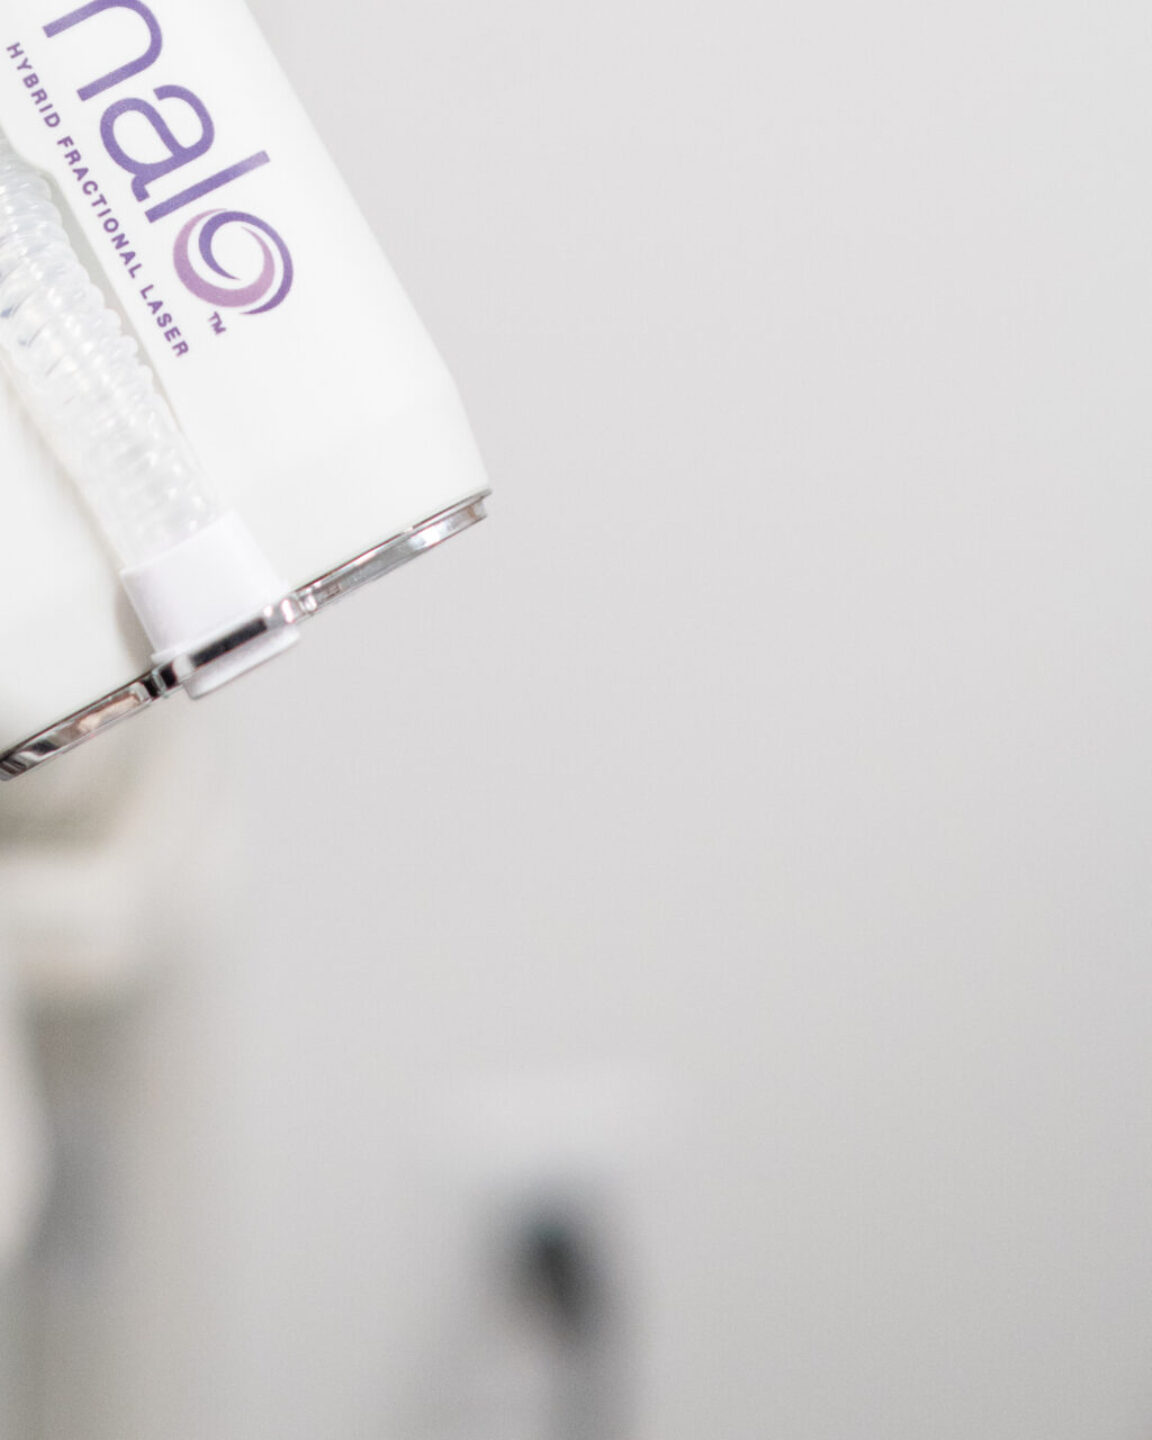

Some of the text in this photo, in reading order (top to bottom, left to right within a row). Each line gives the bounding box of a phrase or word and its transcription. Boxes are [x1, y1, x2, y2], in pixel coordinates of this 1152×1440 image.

[6, 41, 190, 358] HYBRID FRACTIONAL LASER
